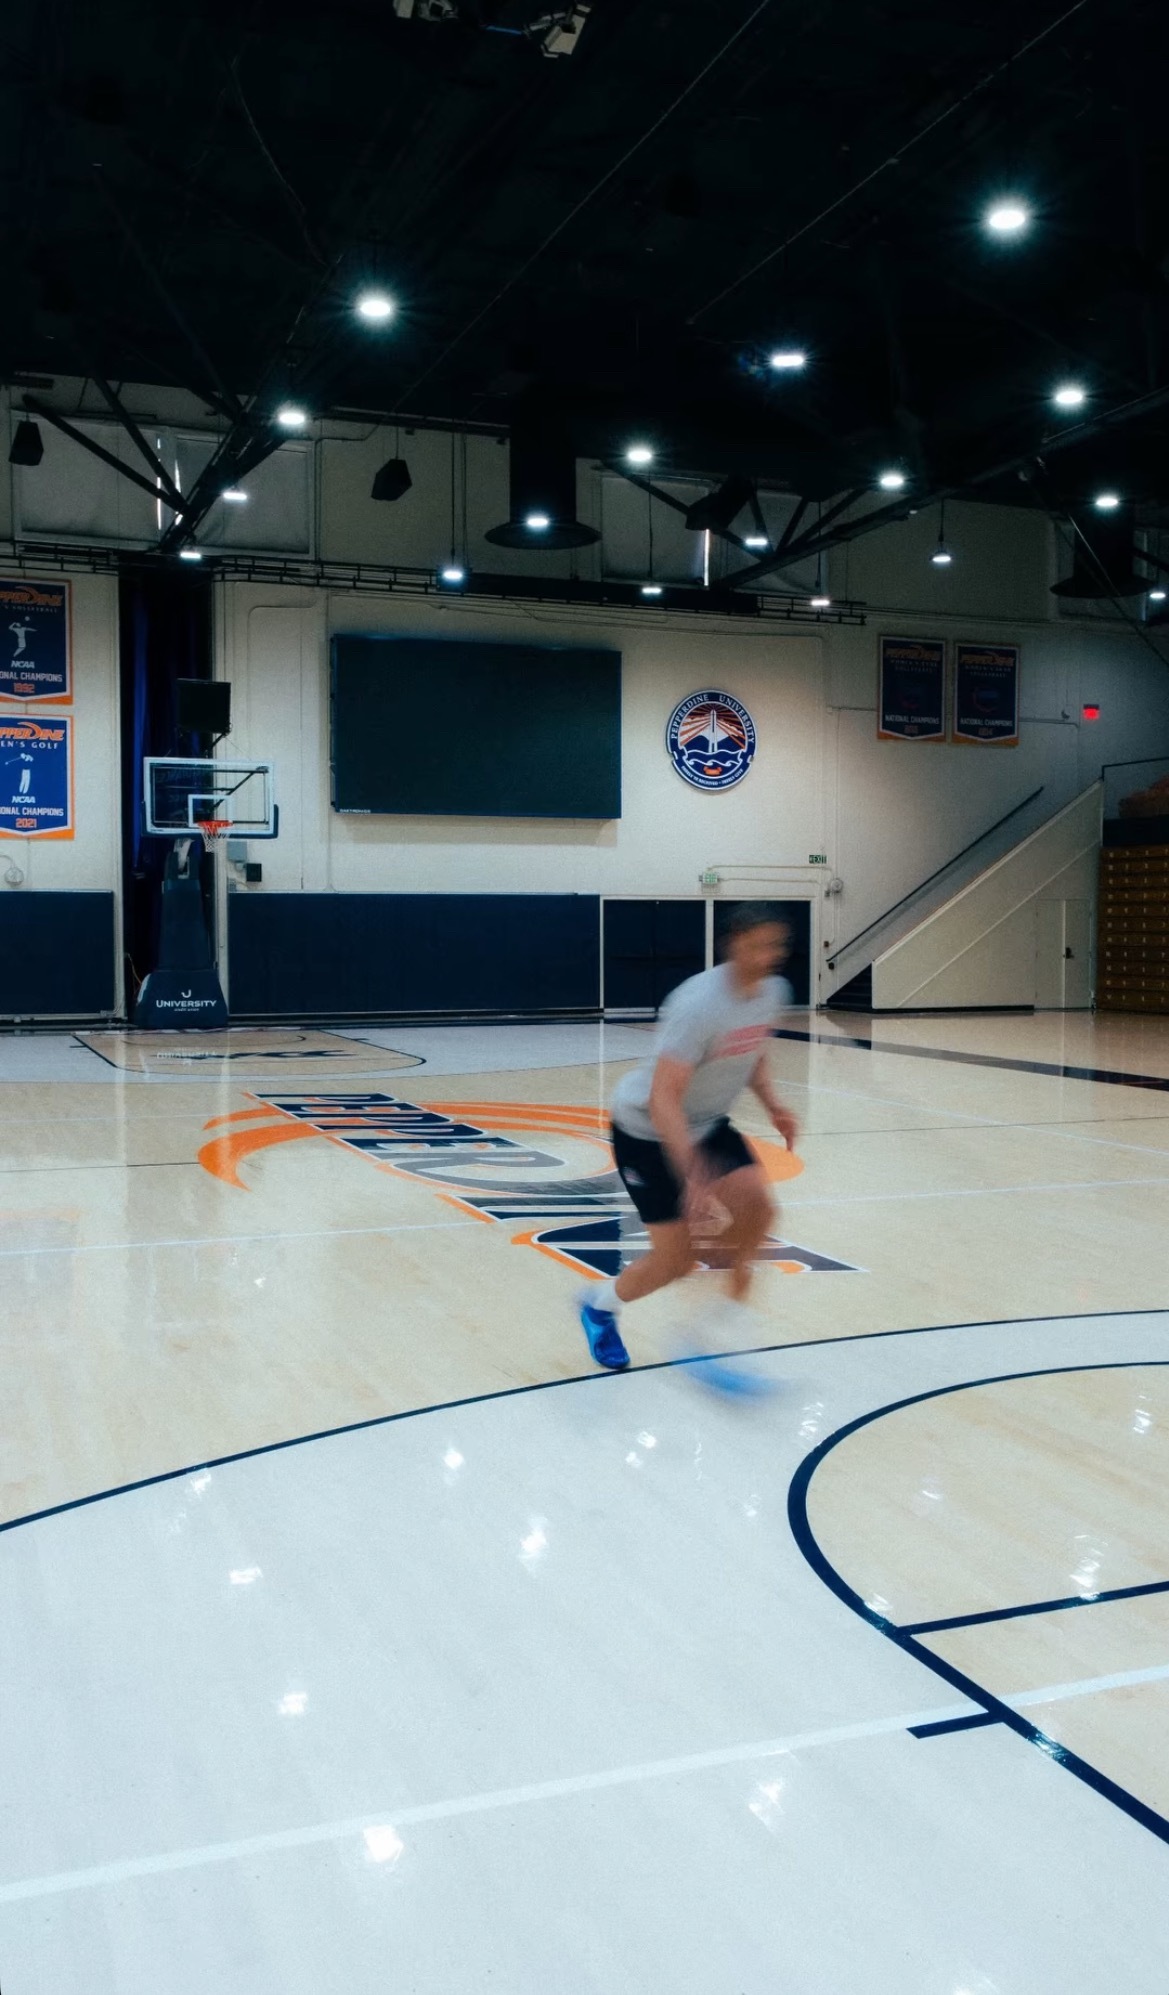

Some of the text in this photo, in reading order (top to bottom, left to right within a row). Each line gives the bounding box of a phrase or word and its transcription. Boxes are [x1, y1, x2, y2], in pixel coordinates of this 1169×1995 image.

[11, 661, 35, 669] NCAA
[20, 673, 63, 682] CHAMPIONS
[671, 694, 755, 744] PEPPERDINE UNIVERSITY
[31, 741, 59, 750] GOLF
[11, 796, 36, 804] NCAA
[22, 807, 64, 817] CHAMPIONS
[15, 818, 37, 828] 2021
[156, 1000, 217, 1008] UNIVERSITY
